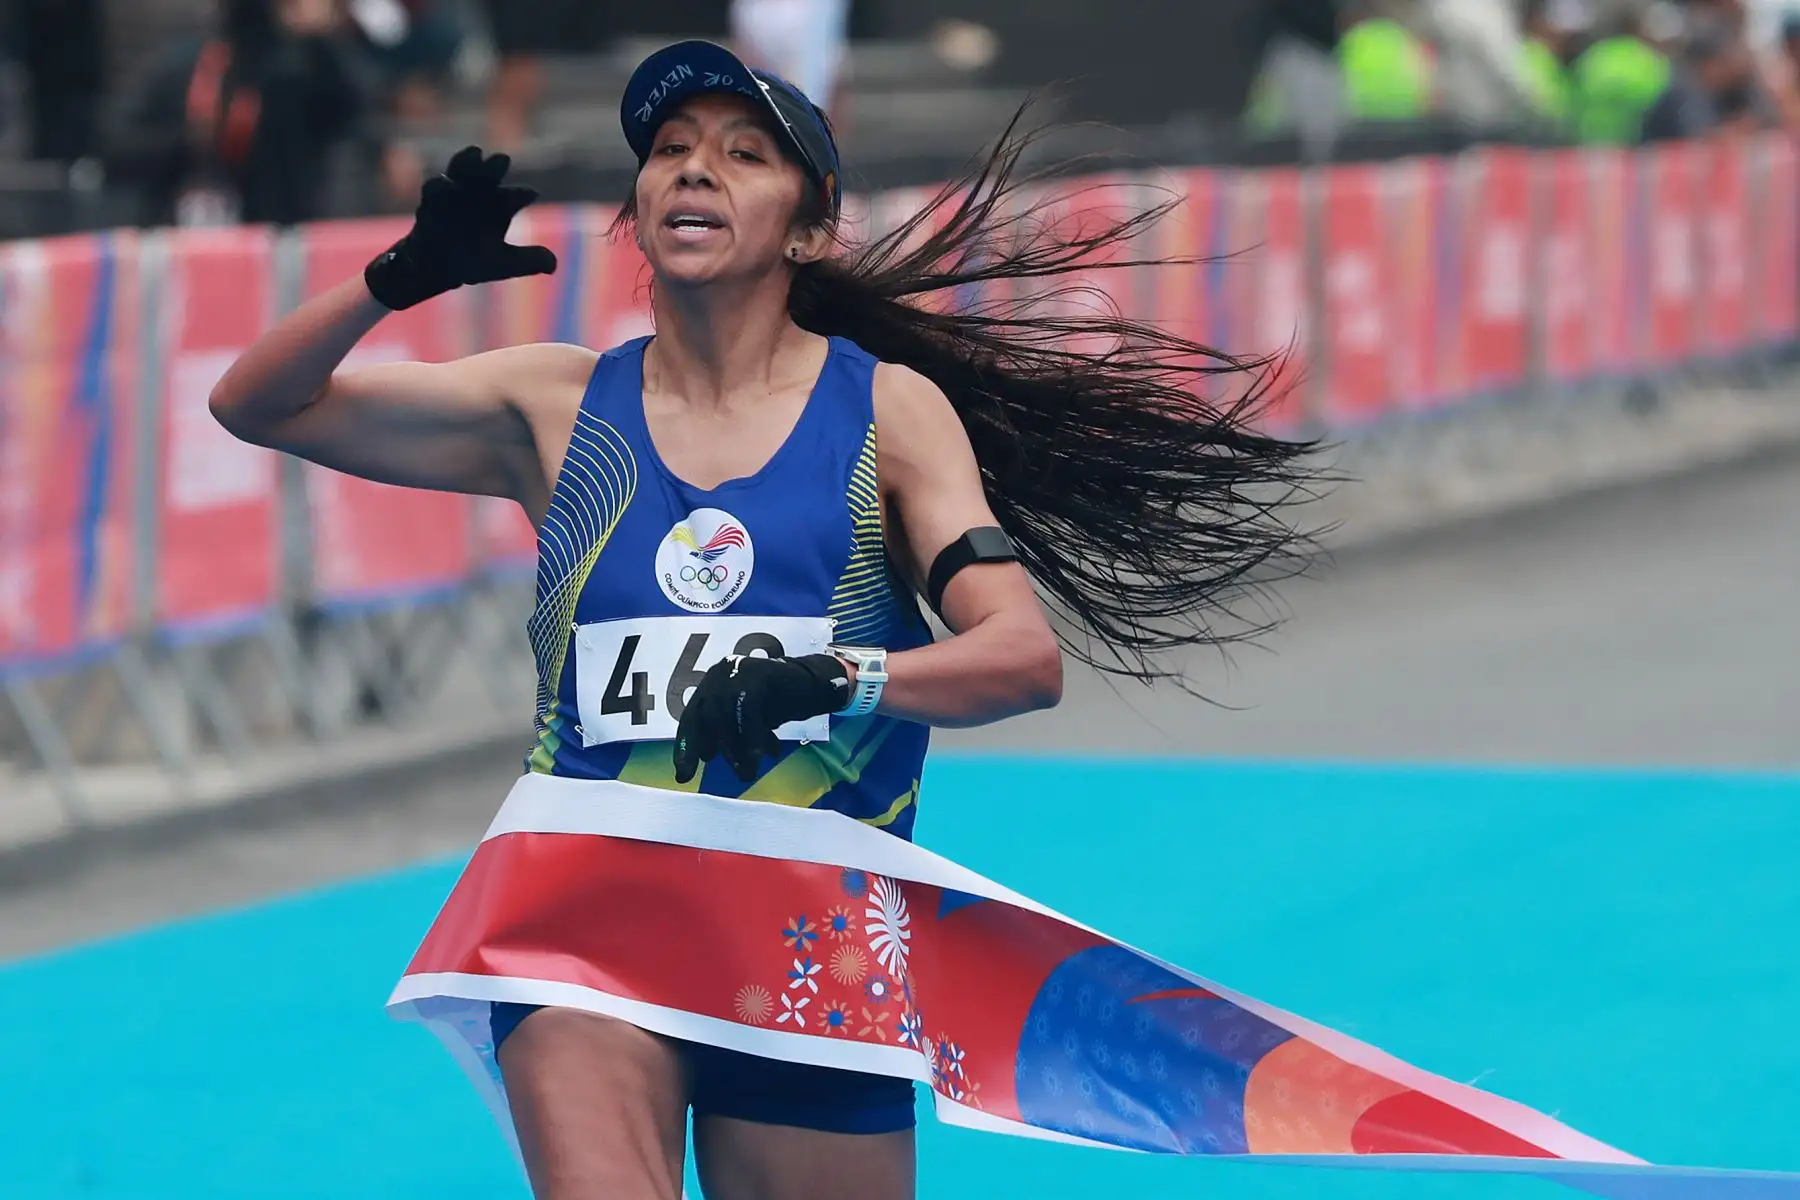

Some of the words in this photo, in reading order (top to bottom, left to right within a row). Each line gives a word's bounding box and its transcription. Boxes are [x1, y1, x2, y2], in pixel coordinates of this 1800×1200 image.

[634, 63, 694, 122] NEVER
[703, 71, 734, 87] OR
[664, 573, 680, 597] COMITÉ
[677, 594, 710, 609] OLÍMPICO
[711, 570, 746, 609] ECUATORIANO
[600, 632, 785, 726] 46
